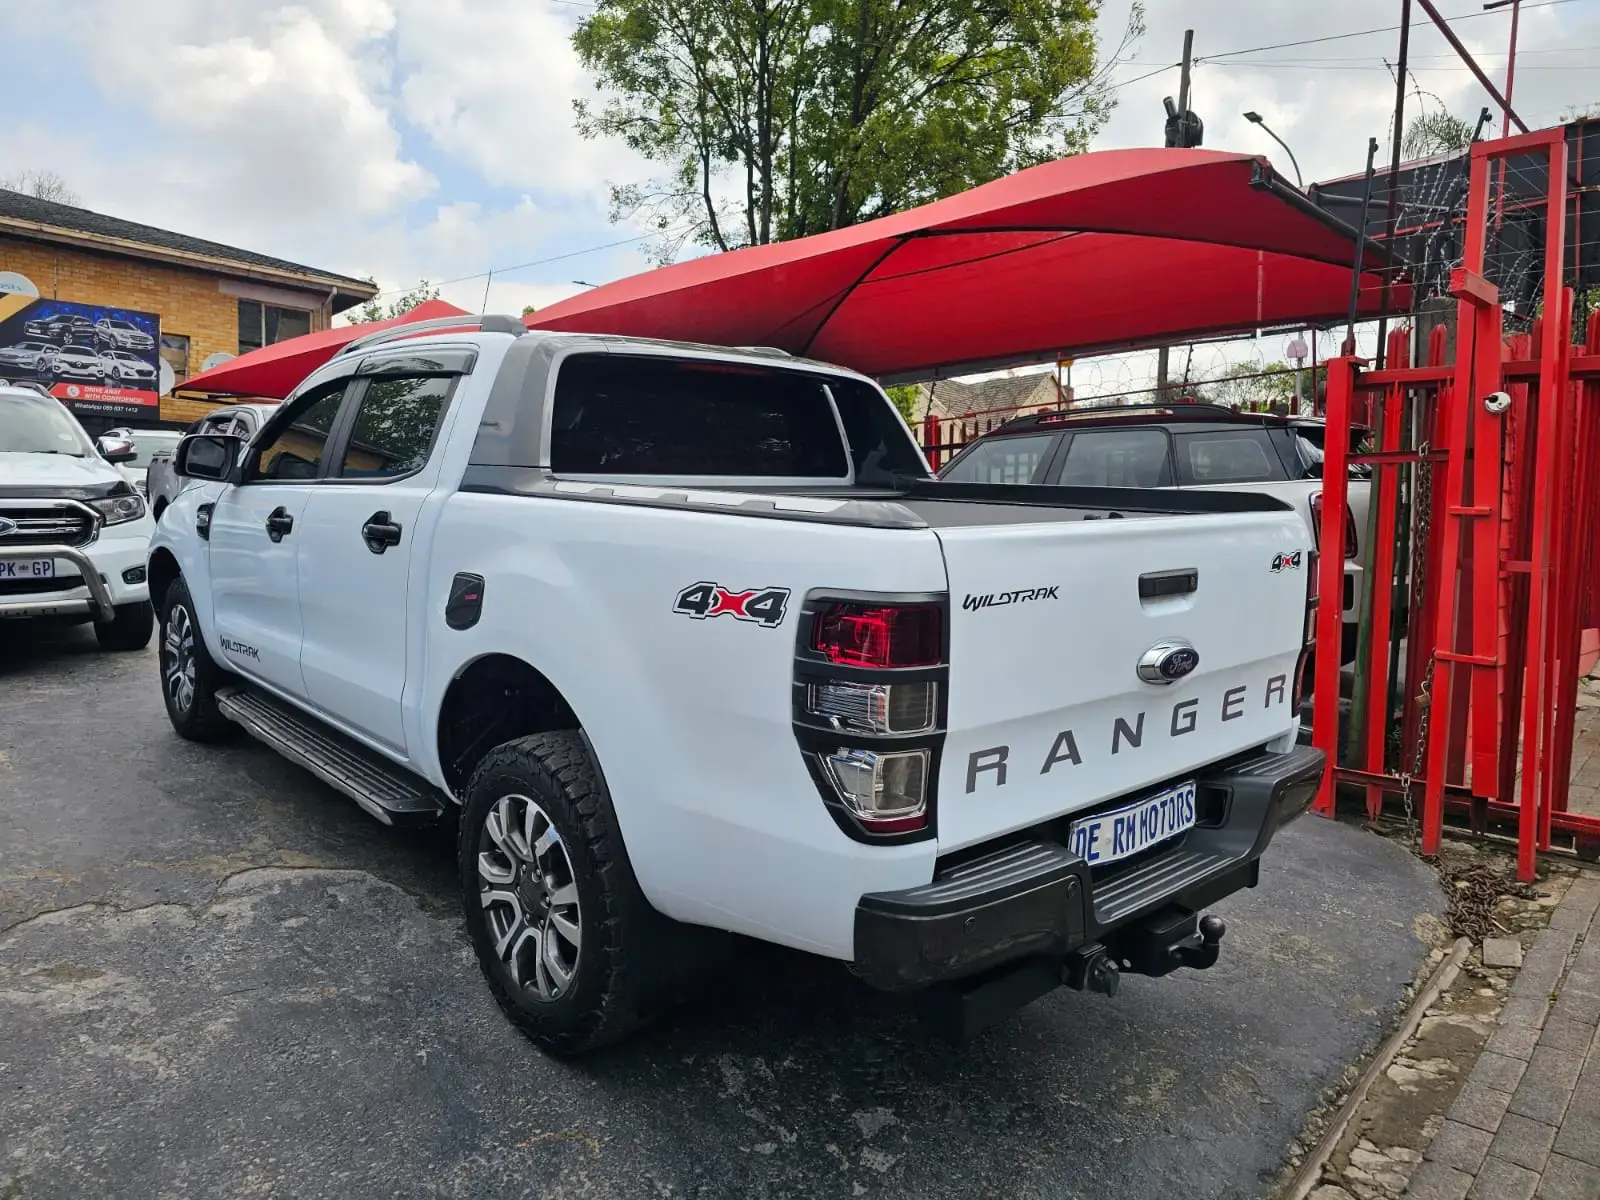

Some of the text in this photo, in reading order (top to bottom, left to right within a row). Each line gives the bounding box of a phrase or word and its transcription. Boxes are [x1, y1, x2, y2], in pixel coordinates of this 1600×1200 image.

[74, 402, 102, 411] WhatsApp
[84, 393, 101, 401] WITH
[32, 561, 51, 577] GP
[962, 585, 1060, 613] WILDTRAK
[219, 634, 261, 663] WILDTRAK
[1169, 653, 1194, 674] Ford
[965, 673, 1287, 794] RANGER
[1139, 788, 1195, 847] MOTORS
